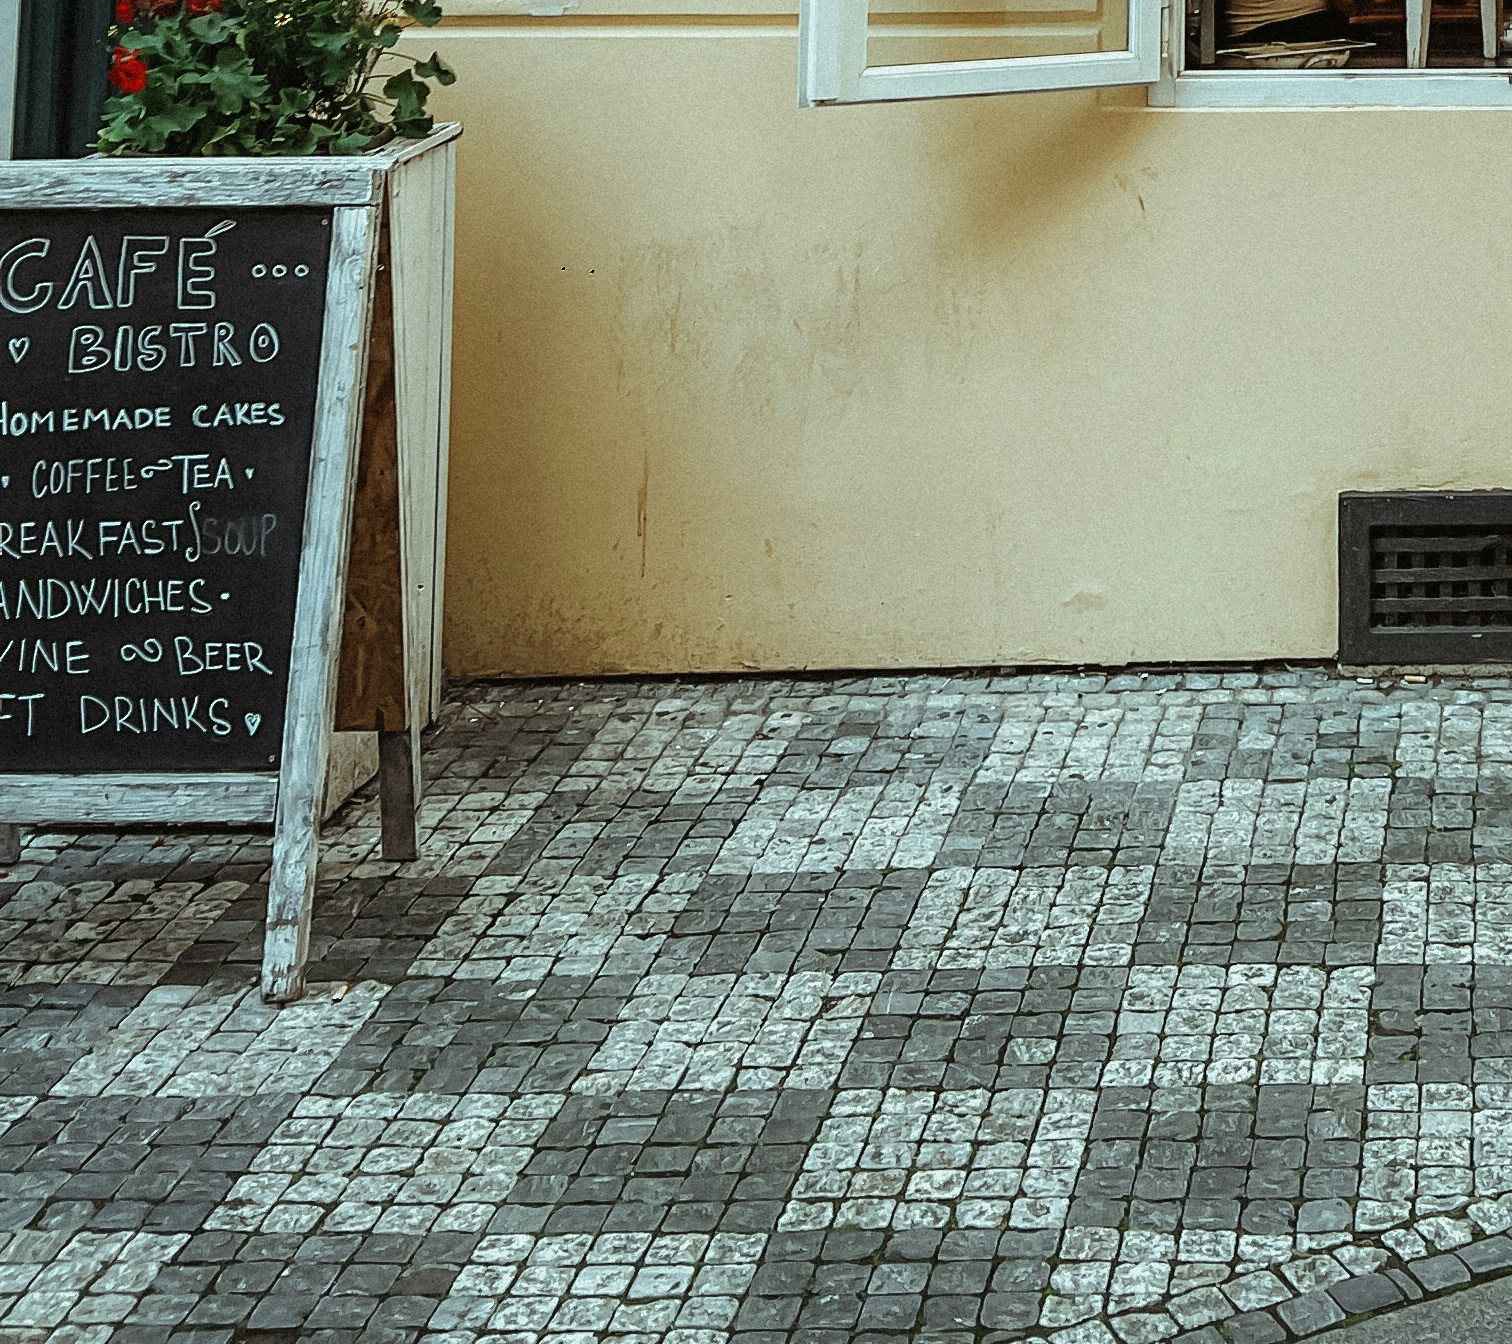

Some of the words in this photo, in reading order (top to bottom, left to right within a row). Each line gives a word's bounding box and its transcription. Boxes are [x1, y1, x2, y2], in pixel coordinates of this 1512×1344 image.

[0, 220, 236, 313] CAFÉ
[68, 322, 279, 373] BISTRO
[193, 403, 285, 427] CAKES
[33, 458, 137, 498] COFFEE
[172, 454, 233, 494] TEA
[201, 512, 277, 558] SOUP
[0, 639, 89, 674] INE
[174, 636, 273, 675] BEER
[81, 696, 231, 735] DRINKS
